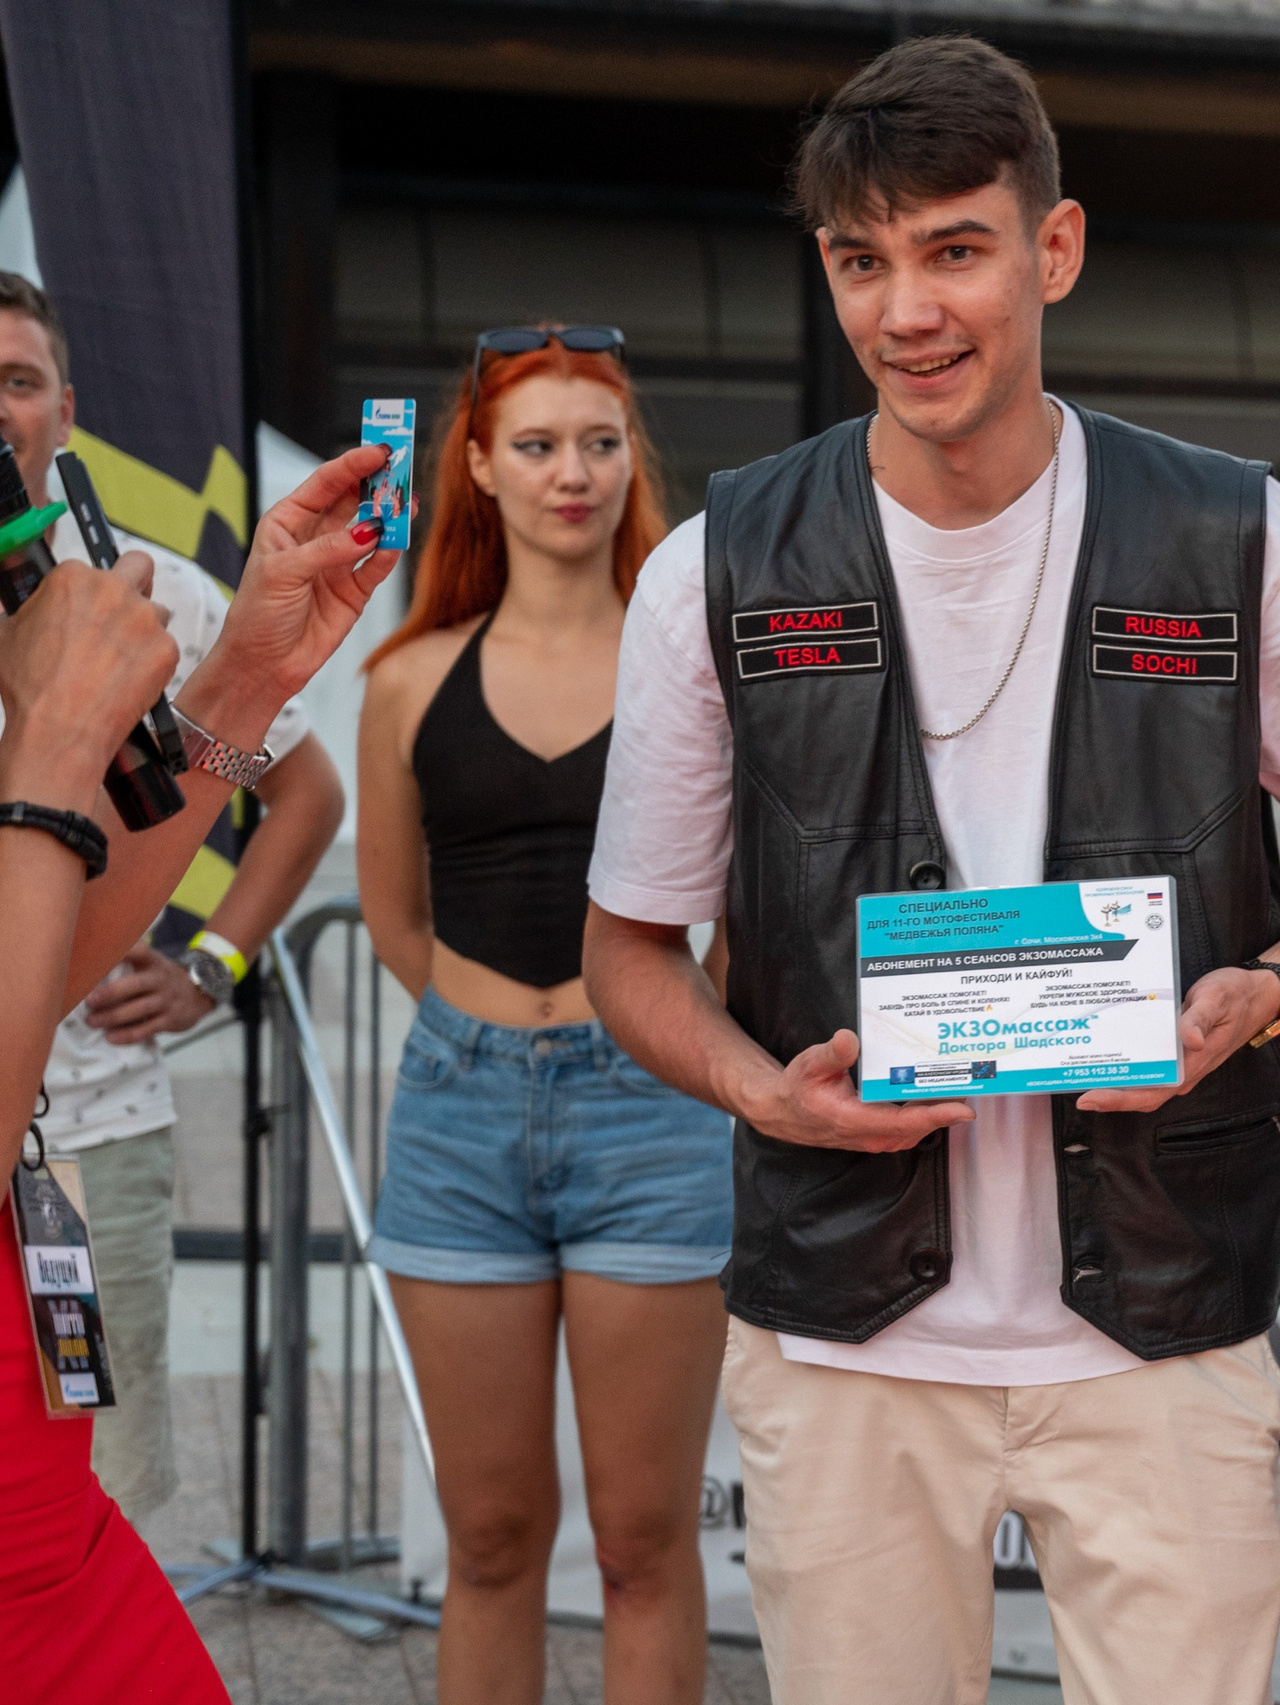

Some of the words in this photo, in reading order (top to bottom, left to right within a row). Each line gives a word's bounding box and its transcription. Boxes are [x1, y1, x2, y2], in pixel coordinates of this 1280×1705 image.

[769, 611, 842, 632] KAZAKI
[1125, 616, 1202, 638] RUSSIA
[774, 647, 841, 667] TESLA
[1131, 654, 1197, 675] SOCHI
[899, 898, 989, 914] СПЕЦИАЛЬНО
[867, 920, 890, 930] ДЛЯ
[893, 917, 921, 928] 11-ГО
[923, 910, 1020, 925] МОТОФЕСТИВАЛЯ
[885, 928, 951, 941] "МЕДВЕЖЬЯ
[953, 925, 1004, 936] ПОЛЯНА"
[1044, 934, 1090, 944] Московская
[867, 958, 935, 972] АБОНЕМЕНТ
[937, 957, 953, 967] НА
[955, 956, 962, 966] 5
[963, 952, 1017, 965] СЕАНСОВ
[1018, 947, 1104, 962] ЭКЗОМАССАЖА
[960, 973, 1013, 985] ПРИХОДИ
[1014, 972, 1023, 981] И
[1025, 968, 1073, 980] КАЙФУЙ!
[1045, 982, 1092, 992] ЭКЗОМАССАЖ
[1066, 990, 1099, 999] МУЖСКОЕ
[901, 992, 948, 1002] ЭКЗОМАССАЖ
[938, 1041, 1006, 1056] Доктора
[1014, 1034, 1092, 1050] Шадского
[1063, 1068, 1073, 1077] +7
[1074, 1067, 1090, 1077] 953
